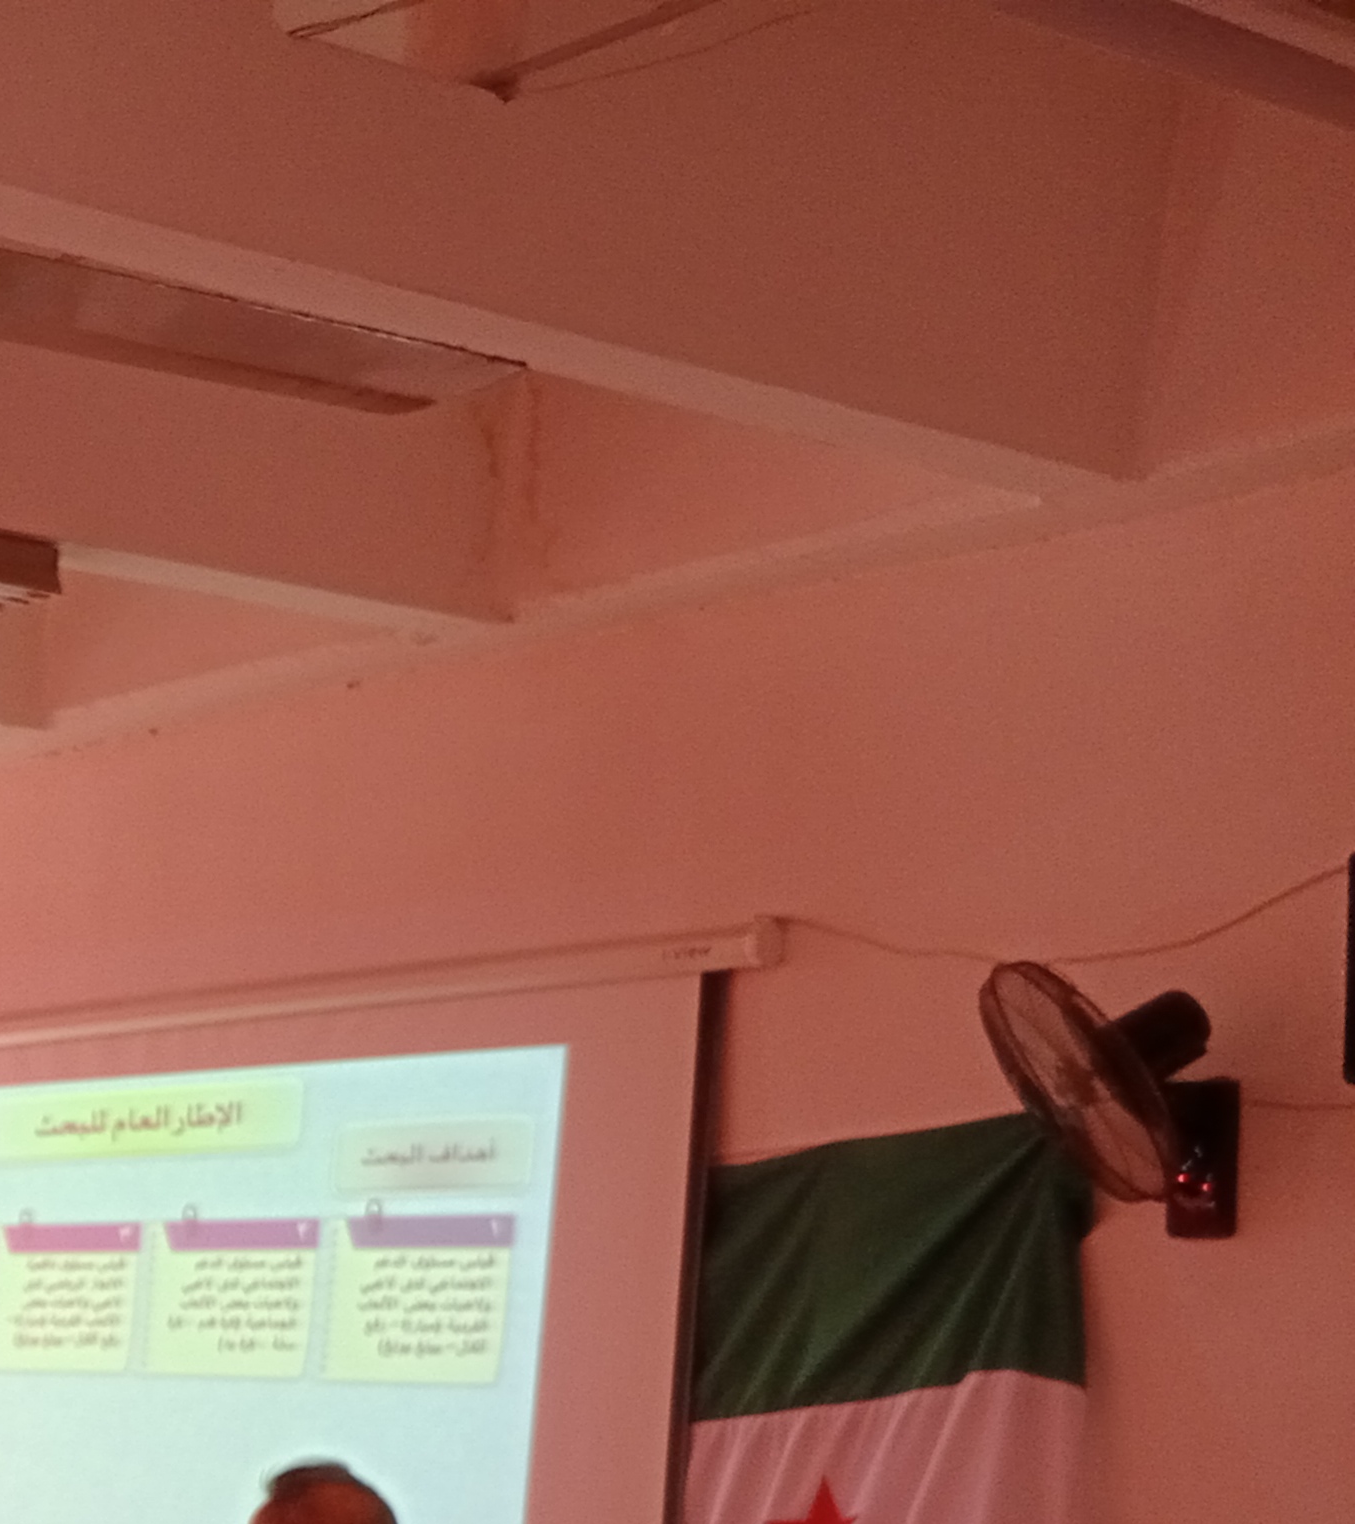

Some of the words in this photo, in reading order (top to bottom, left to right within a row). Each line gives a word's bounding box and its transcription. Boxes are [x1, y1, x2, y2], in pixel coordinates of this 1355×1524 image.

[33, 1108, 106, 1141] للبحث
[110, 1103, 170, 1142] العام
[170, 1100, 243, 1137] الإطار
[360, 1142, 424, 1167] البحث
